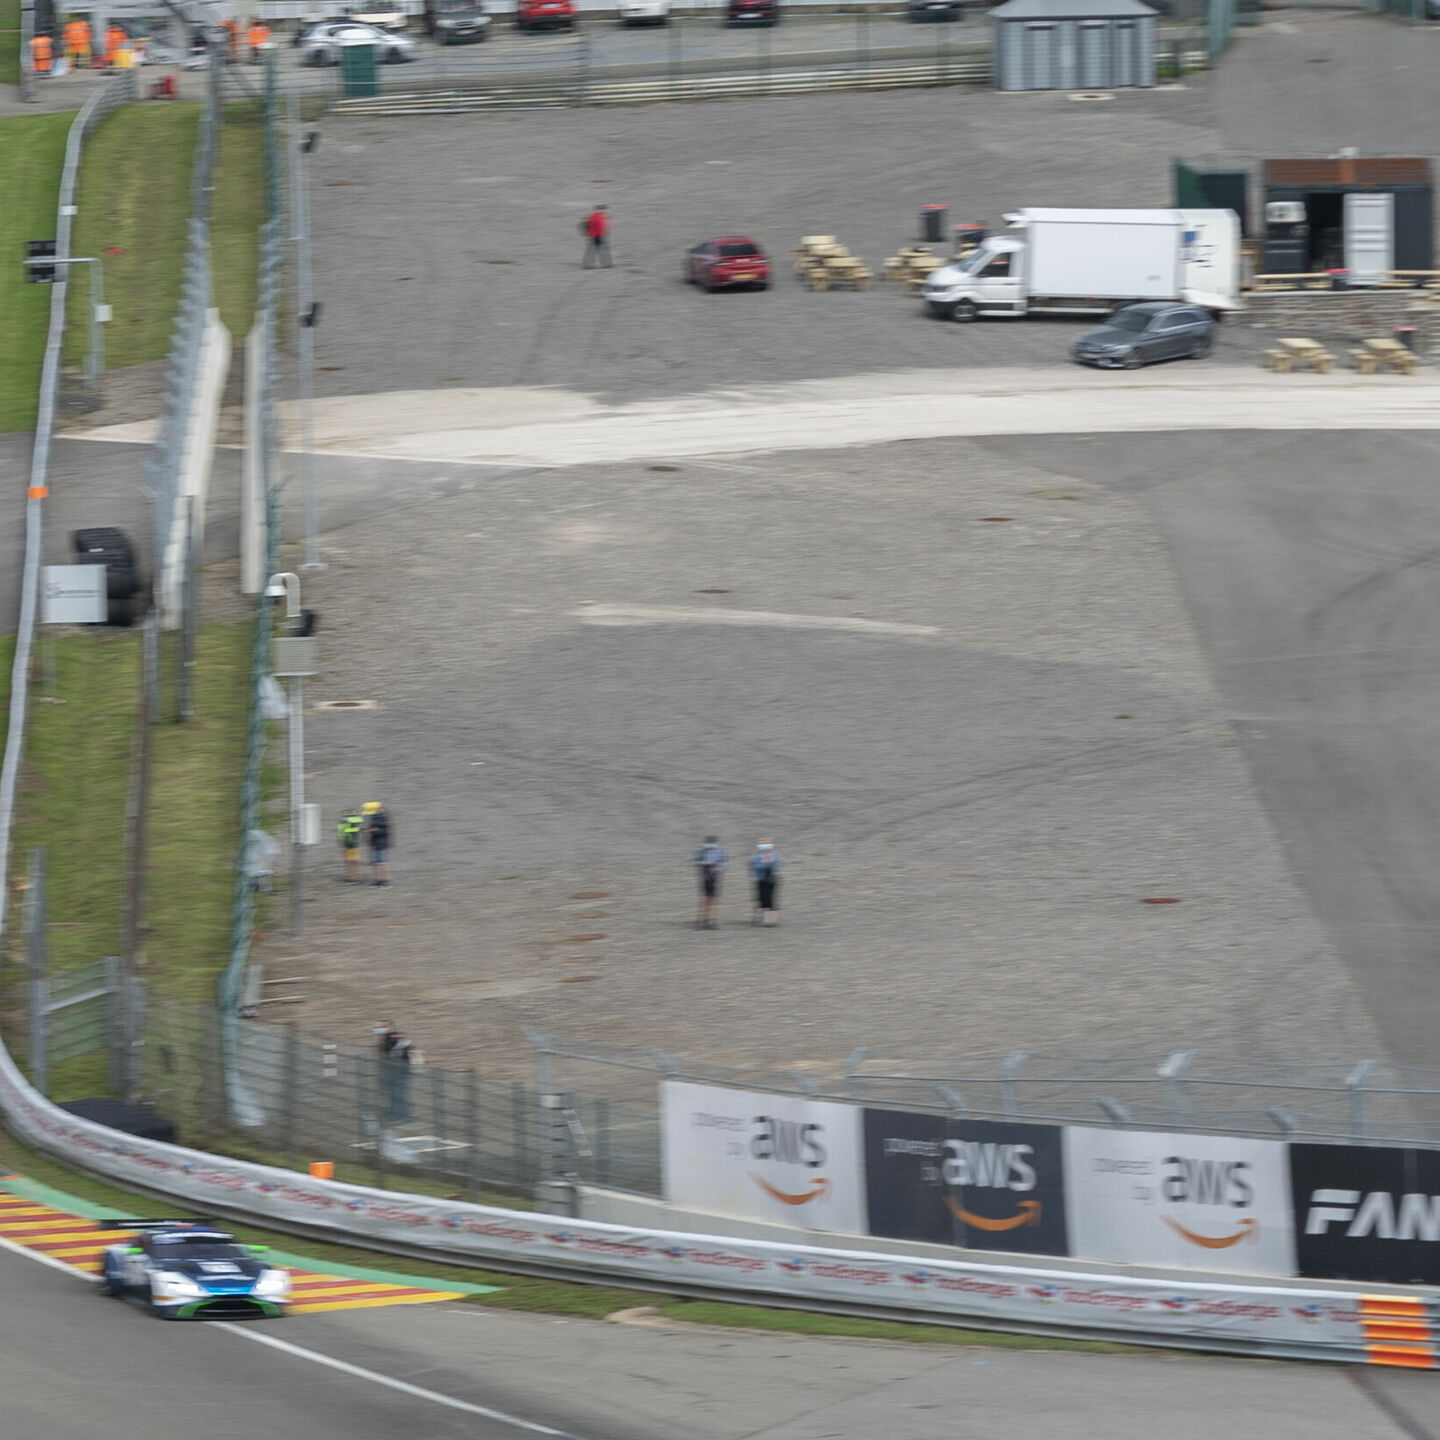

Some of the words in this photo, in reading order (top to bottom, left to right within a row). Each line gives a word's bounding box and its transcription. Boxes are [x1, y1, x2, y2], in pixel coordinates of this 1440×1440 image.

[750, 1115, 828, 1168] aws
[942, 1138, 1038, 1192] aws
[1161, 1156, 1256, 1208] aws
